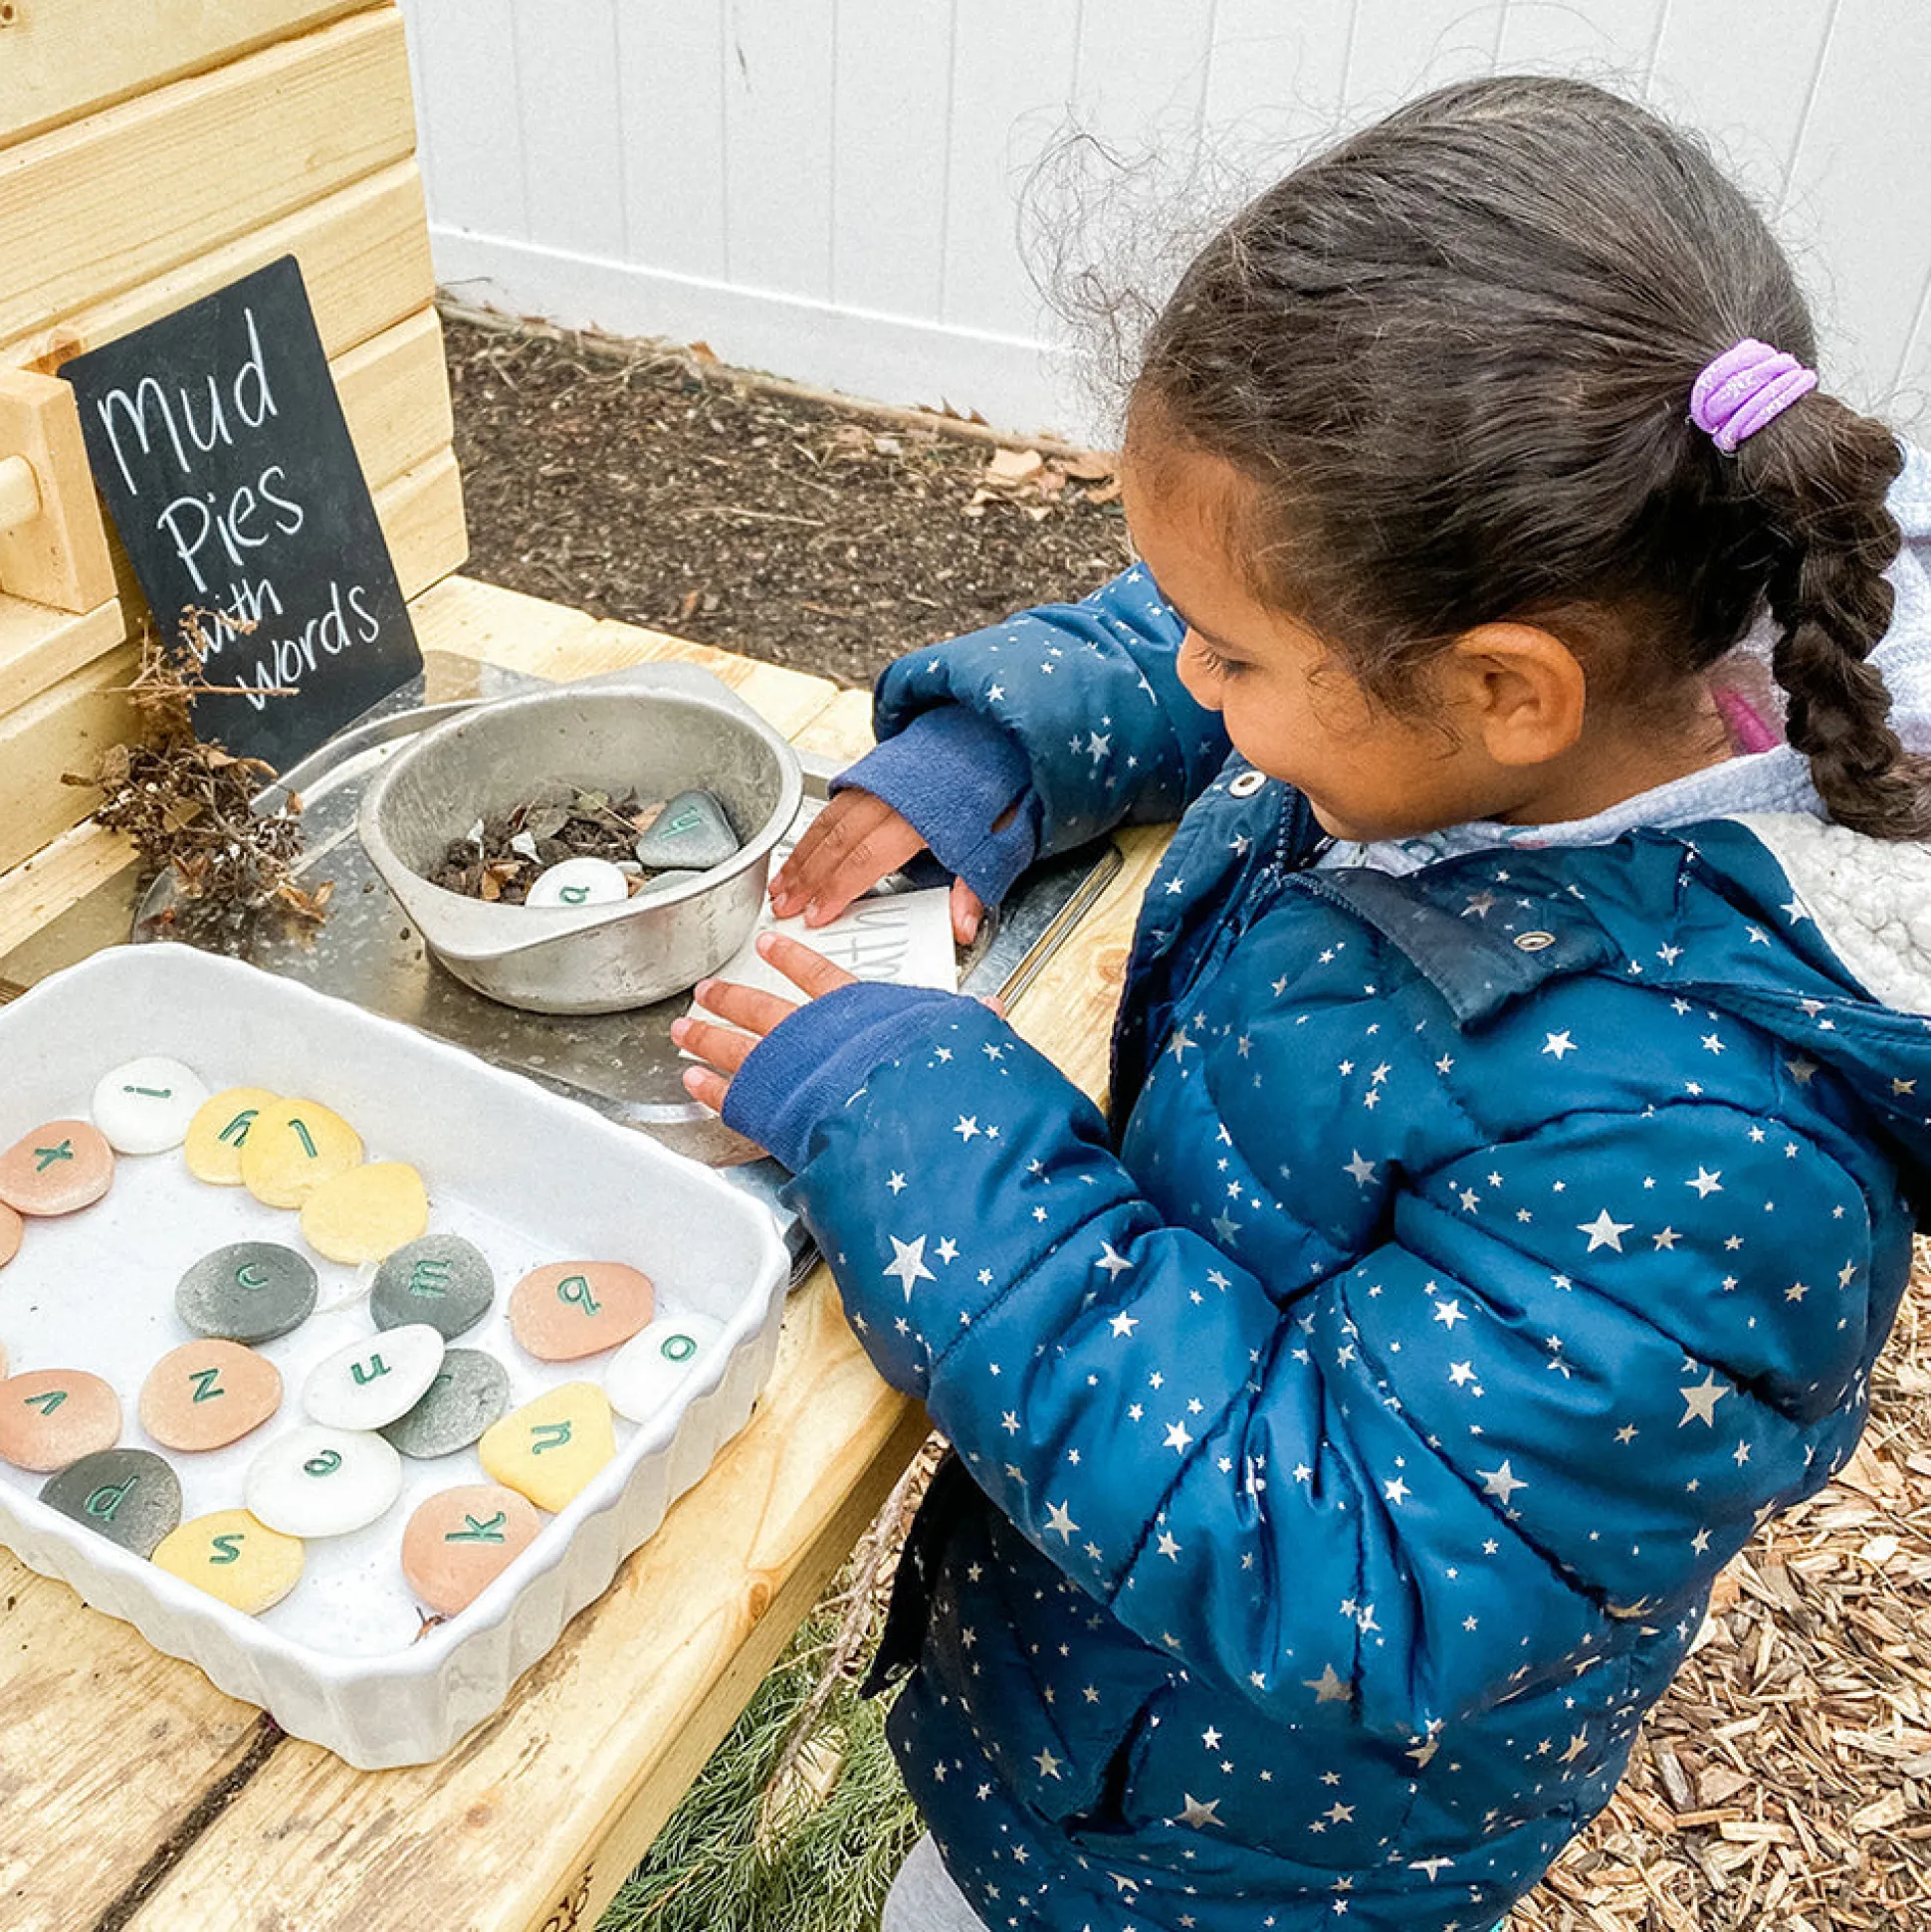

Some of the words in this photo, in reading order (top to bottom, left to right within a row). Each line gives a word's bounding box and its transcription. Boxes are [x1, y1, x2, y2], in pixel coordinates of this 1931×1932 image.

[157, 465, 304, 593] Pies
[181, 577, 284, 664] with
[236, 580, 379, 711] words
[33, 1139, 75, 1173] x
[235, 1262, 270, 1289] c
[660, 1334, 698, 1364] o
[444, 1511, 507, 1545] k
[208, 1533, 246, 1565] s
